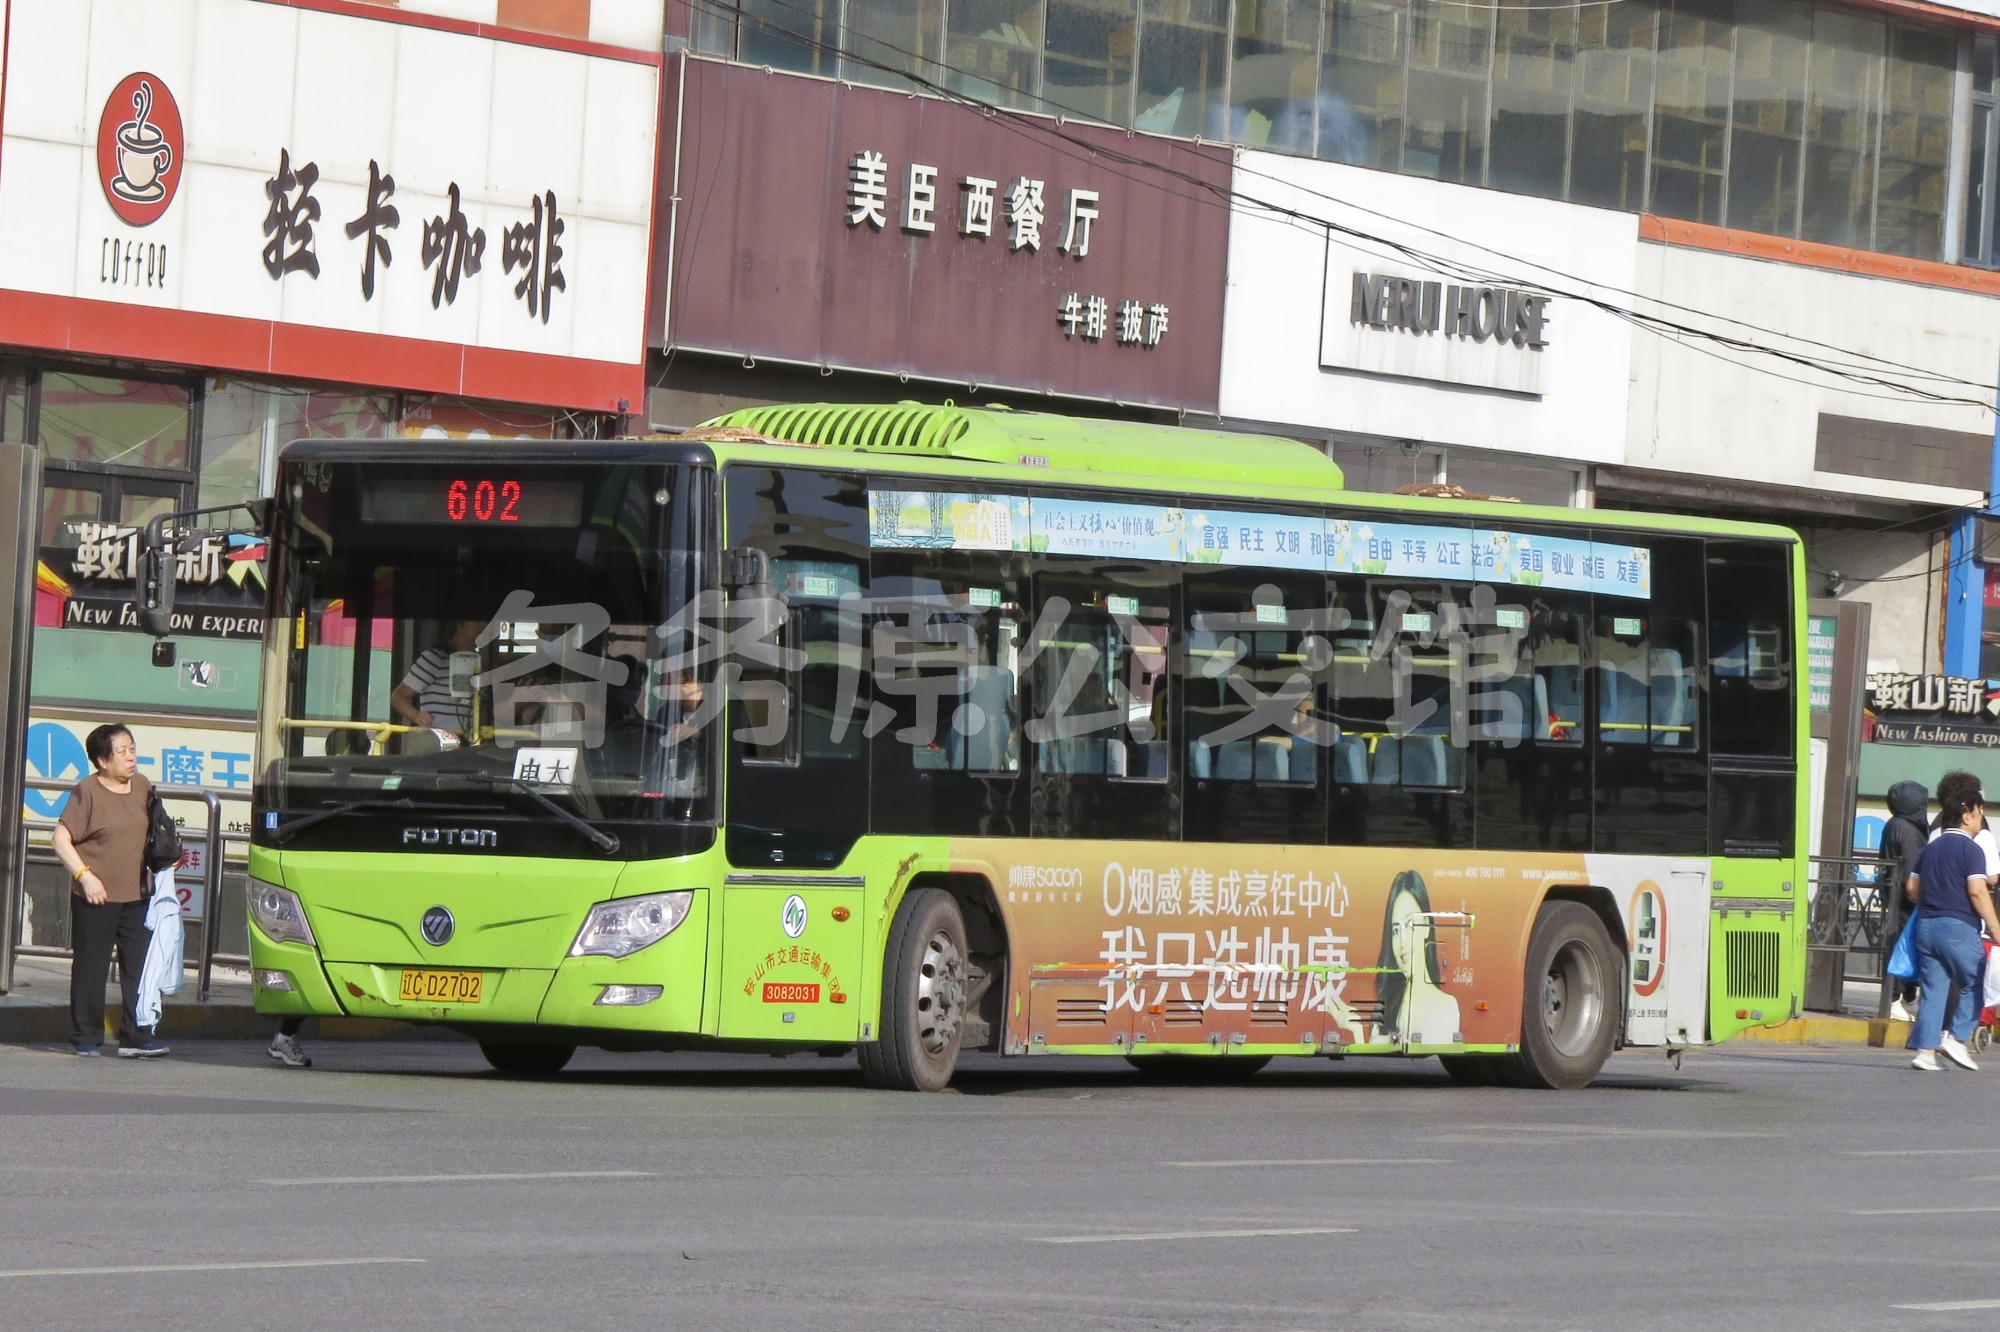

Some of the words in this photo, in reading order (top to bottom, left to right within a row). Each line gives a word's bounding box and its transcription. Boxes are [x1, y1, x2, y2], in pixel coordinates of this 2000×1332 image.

[848, 150, 1100, 260] 美臣西餐厅
[261, 147, 566, 325] 轻卡咖啡
[1058, 292, 1107, 339] 牛排
[1116, 300, 1169, 347] 披萨
[1445, 285, 1553, 352] HOUSE
[447, 480, 521, 521] 602
[1044, 509, 1154, 536] 社会主义核心价值观
[1203, 525, 1228, 550] 富强
[1240, 527, 1264, 551] 民主
[1275, 529, 1300, 554] 文明
[1311, 532, 1335, 557] 和谐
[1368, 537, 1392, 561] 自由
[1402, 539, 1426, 564] 平等
[1436, 541, 1460, 566] 公正
[1471, 543, 1494, 568] 法治
[1519, 548, 1543, 573] 爱国
[1551, 551, 1574, 576] 敬业
[1582, 555, 1605, 579] 诚信
[1616, 559, 1639, 583] 友善
[520, 757, 576, 787] 电大
[402, 827, 497, 847] FOTON
[743, 945, 840, 997] 鞍山市交通运输集团
[1099, 926, 1349, 1012] 我只选帅康
[767, 986, 815, 1000] 3082031
